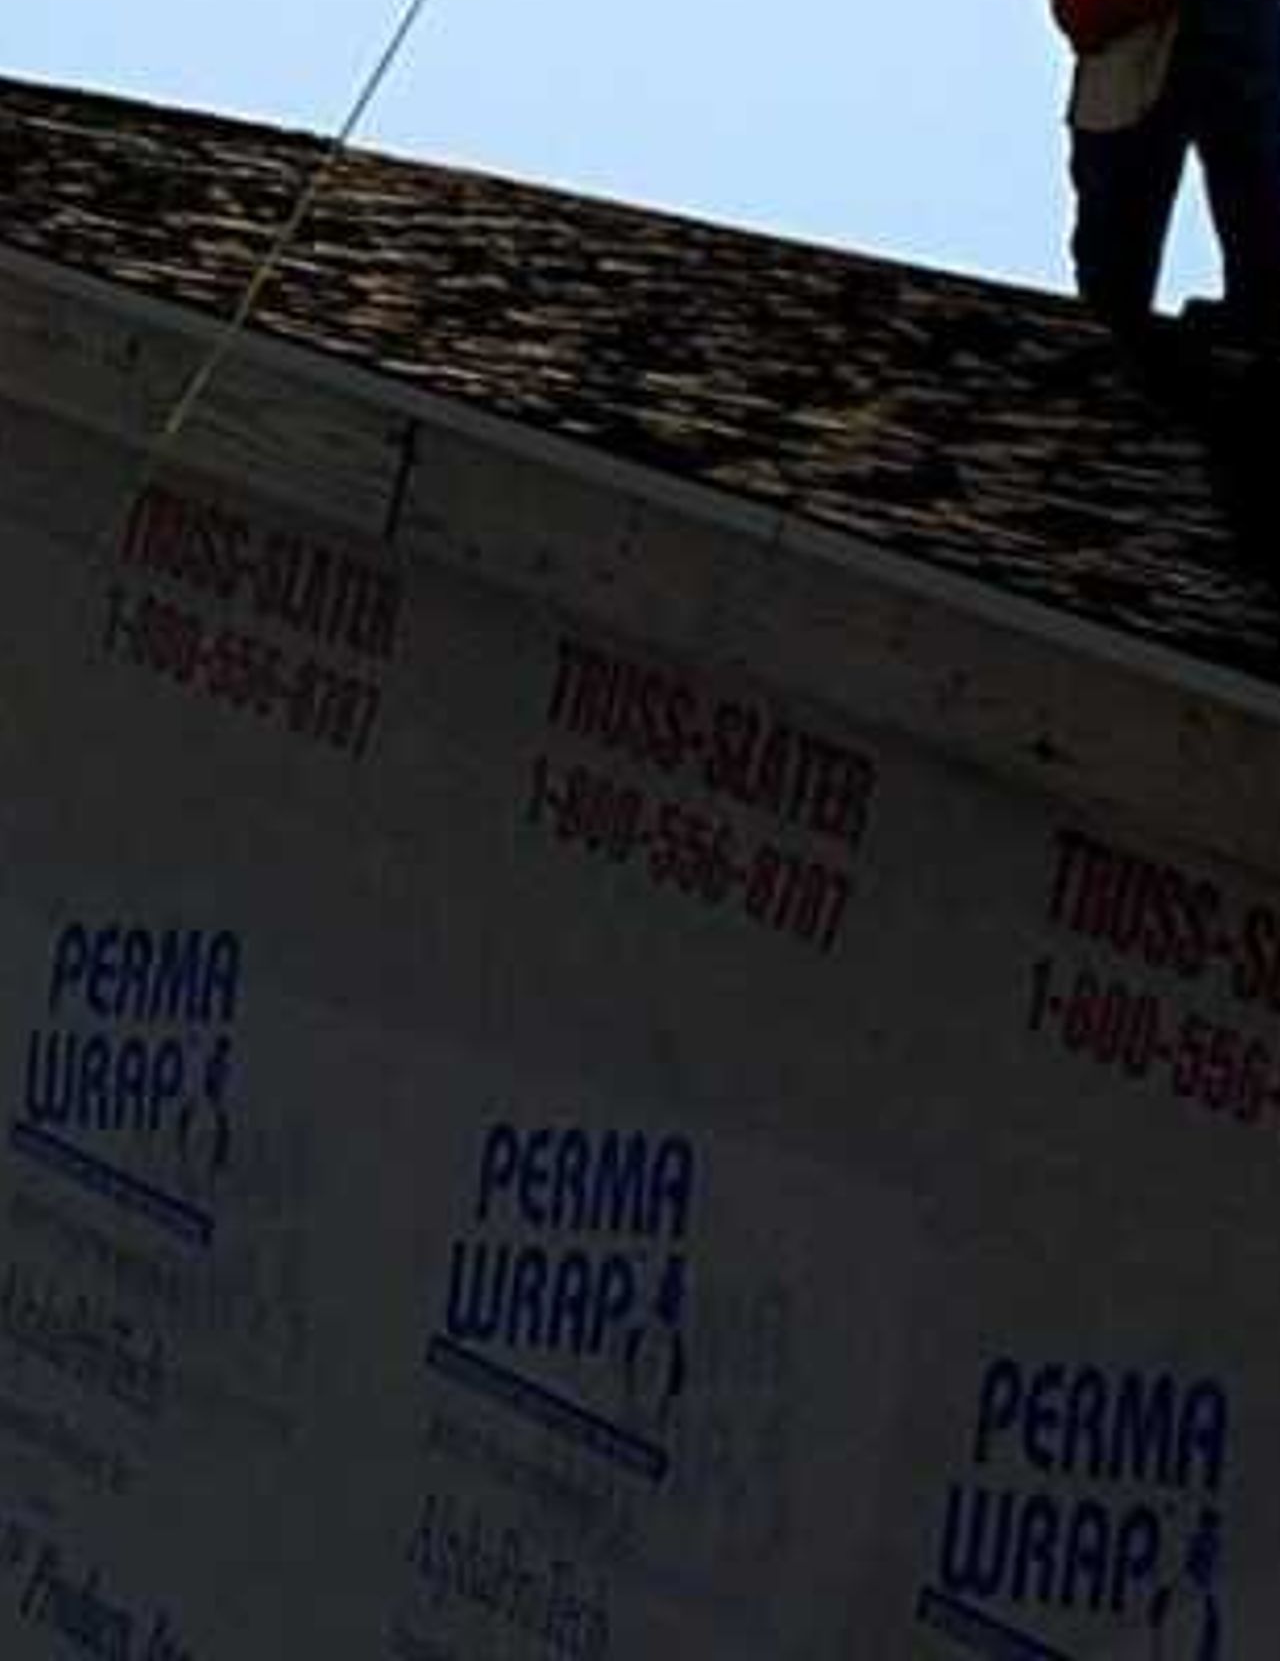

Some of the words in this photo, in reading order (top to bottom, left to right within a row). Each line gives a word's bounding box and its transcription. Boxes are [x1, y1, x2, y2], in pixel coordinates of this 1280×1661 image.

[48, 921, 242, 1025] PERMA
[24, 1029, 185, 1132] WRAP
[476, 1123, 694, 1238] PERMA
[447, 1241, 635, 1357] WRAP
[974, 1359, 1228, 1489] PERMA
[940, 1485, 1161, 1614] WRAP
